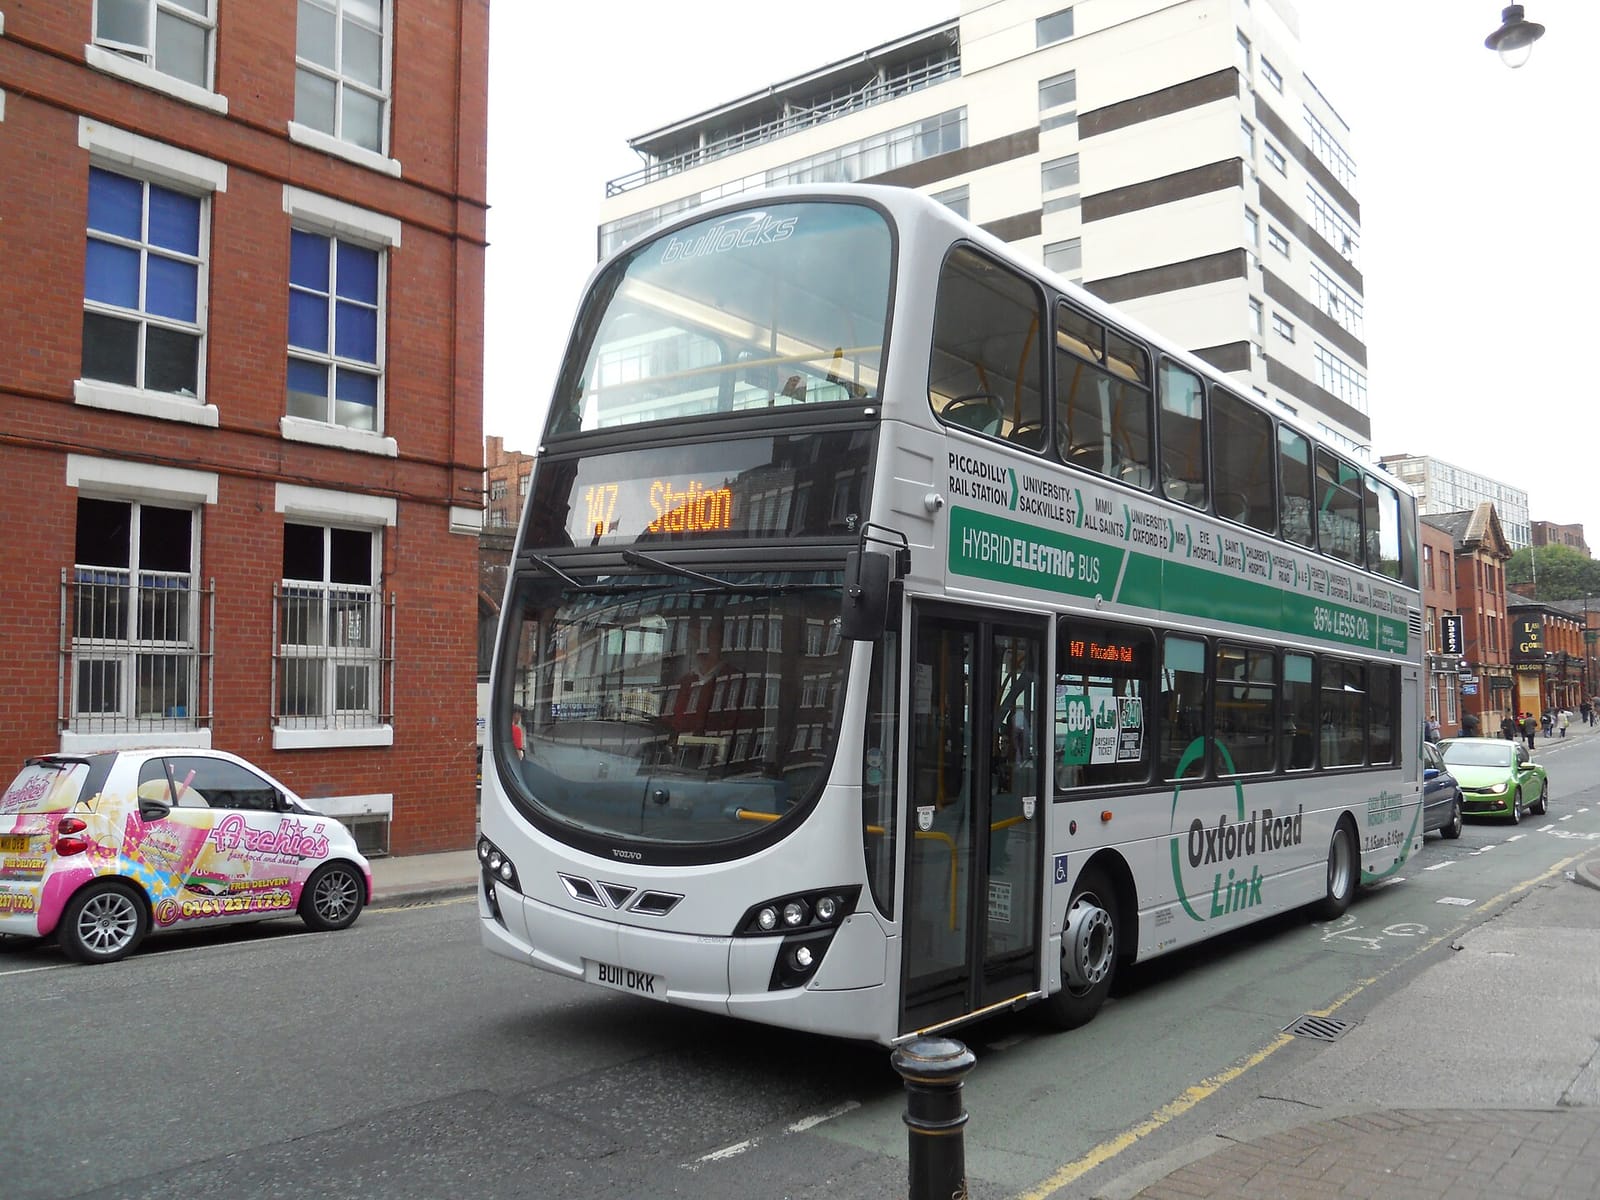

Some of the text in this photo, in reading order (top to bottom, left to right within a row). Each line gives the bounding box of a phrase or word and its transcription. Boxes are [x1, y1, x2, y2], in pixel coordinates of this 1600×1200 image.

[661, 216, 798, 265] bullocks
[949, 452, 1007, 485] PICCADILLY
[949, 475, 1008, 507] RAIL STATION
[585, 480, 733, 536] 147 Station
[1020, 496, 1076, 525] SACKVILLE ST
[1095, 498, 1112, 516] MMU
[1084, 515, 1124, 538] ALL SAINTS
[1132, 528, 1158, 547] OXFORD
[1199, 530, 1210, 544] EYE
[1192, 545, 1218, 563] HOSPITAL
[1224, 538, 1239, 553] SAINT
[1078, 555, 1100, 584] BUS
[1313, 605, 1332, 633] 35%
[1333, 611, 1355, 638] LESS
[1070, 640, 1084, 657] 147
[1068, 700, 1091, 735] 80p
[1098, 747, 1113, 756] TICKET
[210, 813, 330, 859] Archie's
[1188, 804, 1303, 868] Oxford Road
[227, 850, 299, 865] fast food and shakes
[612, 849, 642, 860] VOLVO
[230, 877, 289, 890] FREE DELIVERY
[1210, 865, 1264, 919] Link
[182, 899, 220, 916] 0161
[223, 896, 252, 912] 237
[599, 962, 655, 994] BU11 OKK
